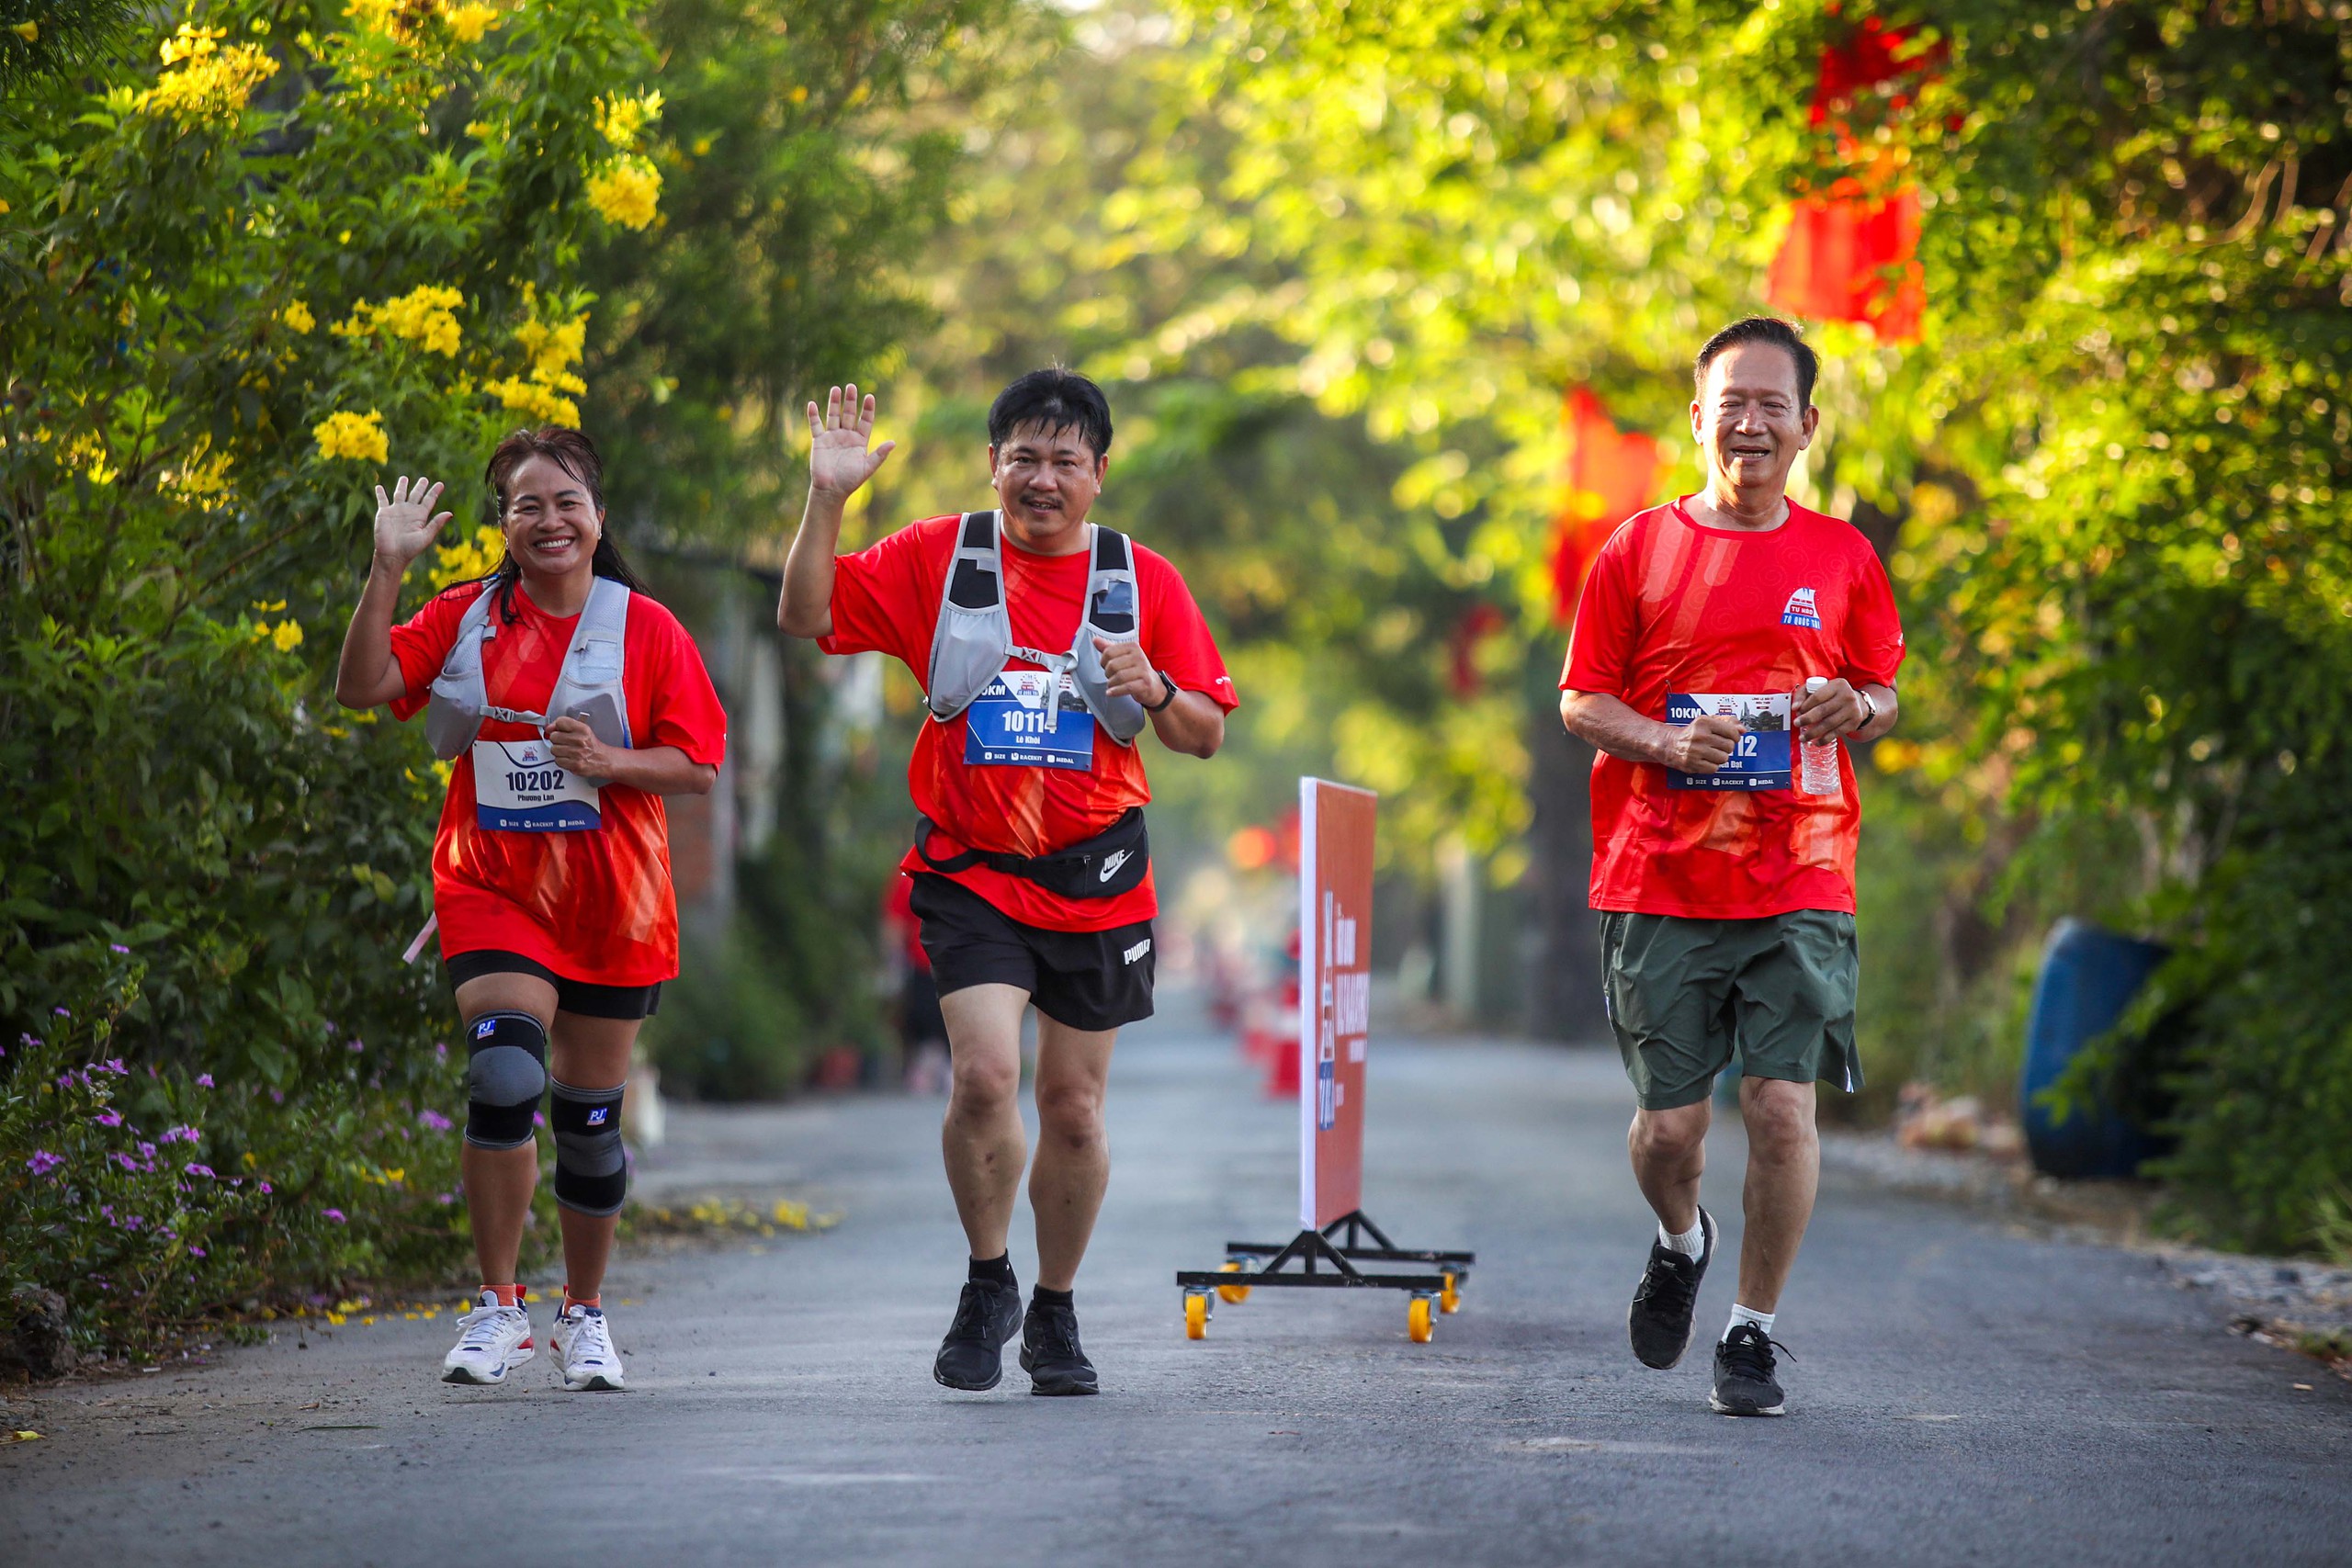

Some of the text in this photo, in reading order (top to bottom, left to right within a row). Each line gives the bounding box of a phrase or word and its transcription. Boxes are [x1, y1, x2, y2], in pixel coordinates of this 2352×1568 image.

[1670, 707, 1702, 719] 10KM
[505, 770, 565, 791] 10202
[1103, 849, 1125, 872] NIKE
[1124, 938, 1151, 965] PUMA
